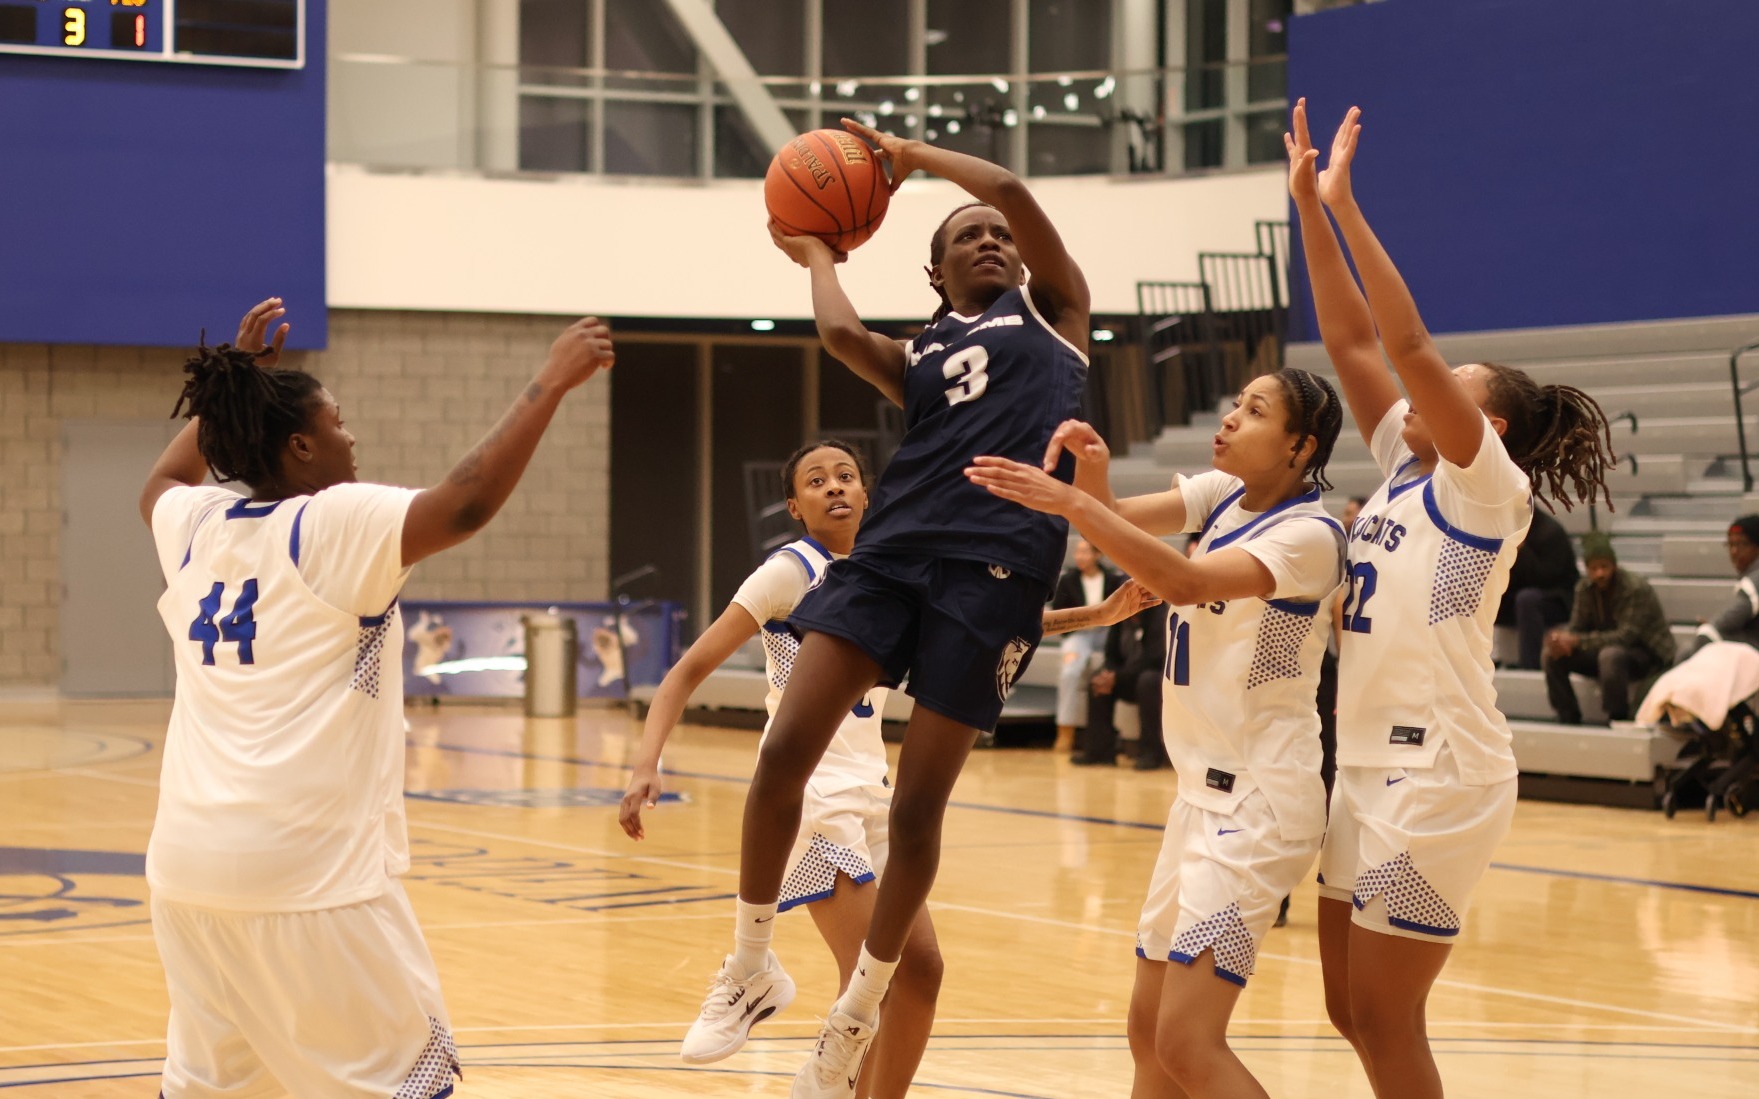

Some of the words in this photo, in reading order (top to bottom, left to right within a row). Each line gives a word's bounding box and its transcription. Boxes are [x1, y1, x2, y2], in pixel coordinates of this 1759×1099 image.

[64, 7, 85, 46] 3
[135, 14, 145, 47] 1
[794, 139, 836, 190] SPALDIN
[942, 344, 990, 407] 3
[1350, 514, 1407, 553] LDCATS
[188, 577, 259, 666] 44
[1342, 559, 1378, 635] 22
[1165, 611, 1190, 687] 11
